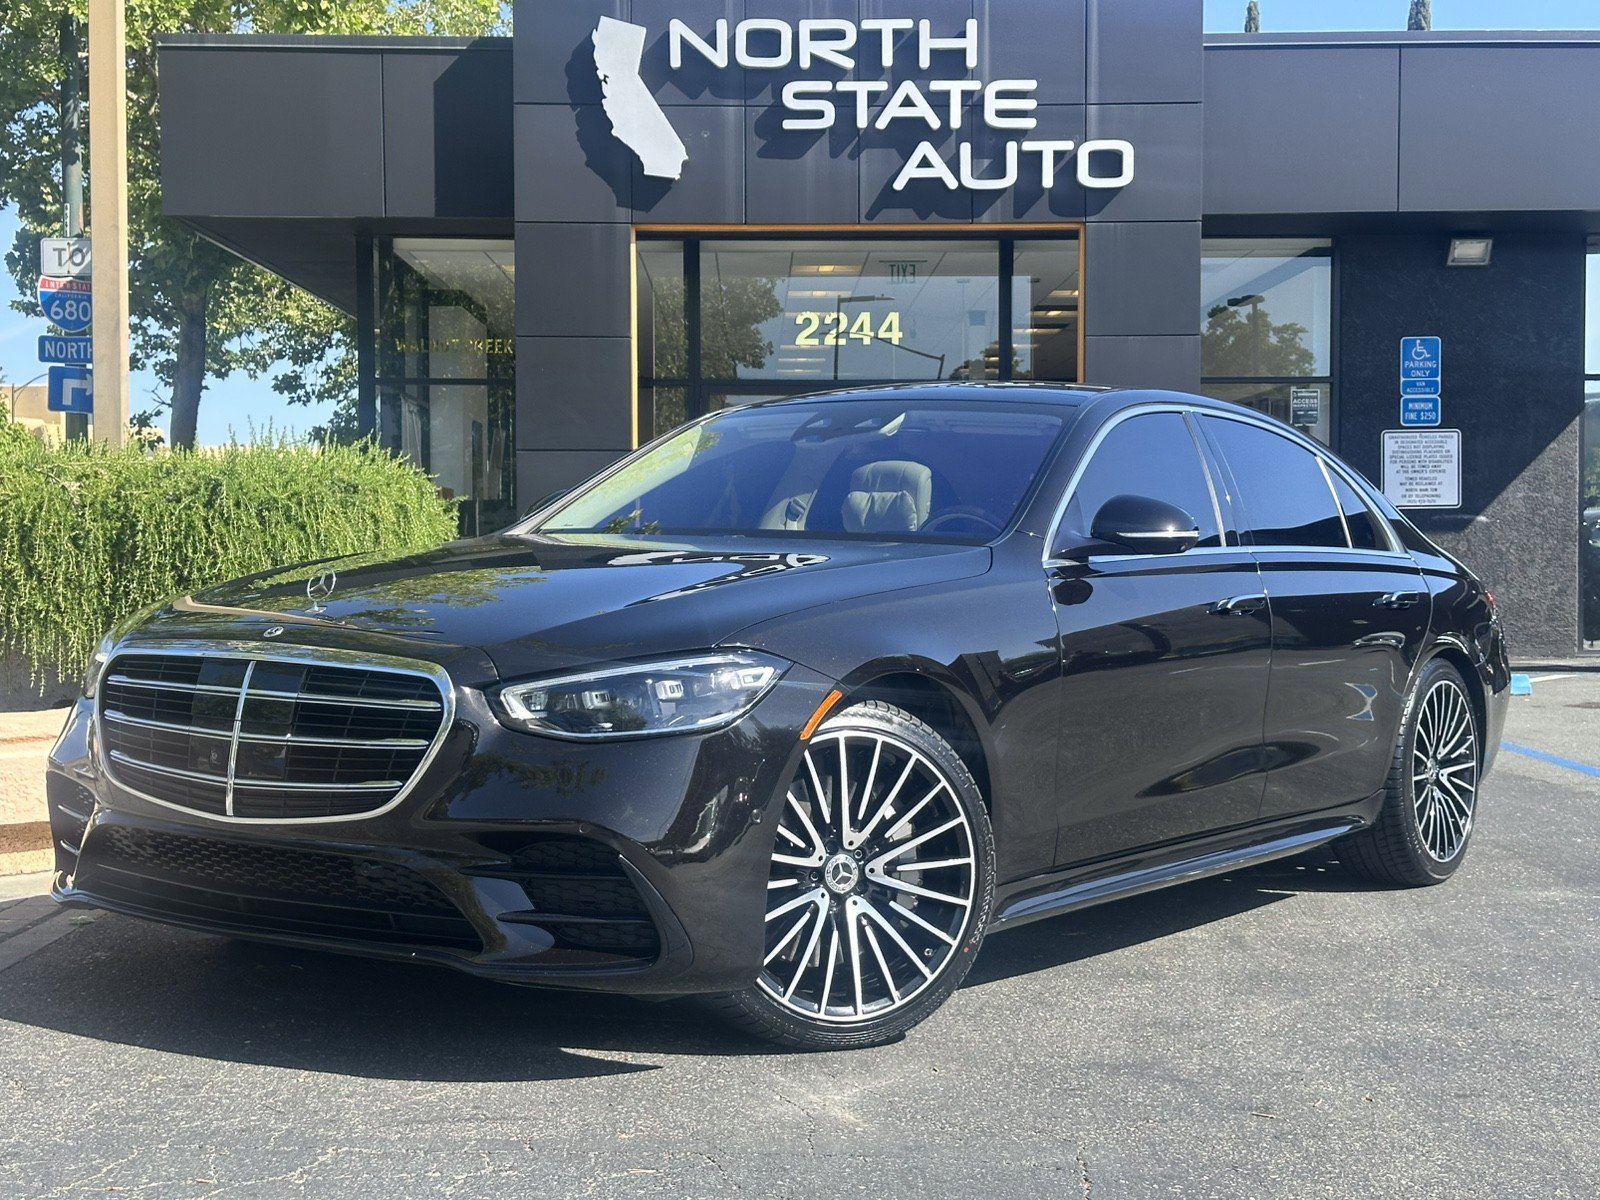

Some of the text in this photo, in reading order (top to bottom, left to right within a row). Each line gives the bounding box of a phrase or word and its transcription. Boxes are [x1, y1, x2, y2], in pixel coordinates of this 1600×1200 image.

[668, 18, 978, 69] NORTH
[782, 79, 1038, 130] STATE
[892, 139, 1135, 191] AUTO
[52, 247, 86, 267] TO
[45, 280, 92, 292] INTERSTAT
[50, 300, 92, 322] 680
[795, 311, 903, 345] 2244
[465, 338, 513, 354] REEK
[1404, 360, 1437, 368] PARKING
[1404, 411, 1437, 421] FINE $250
[1408, 402, 1433, 410] MINIMUM
